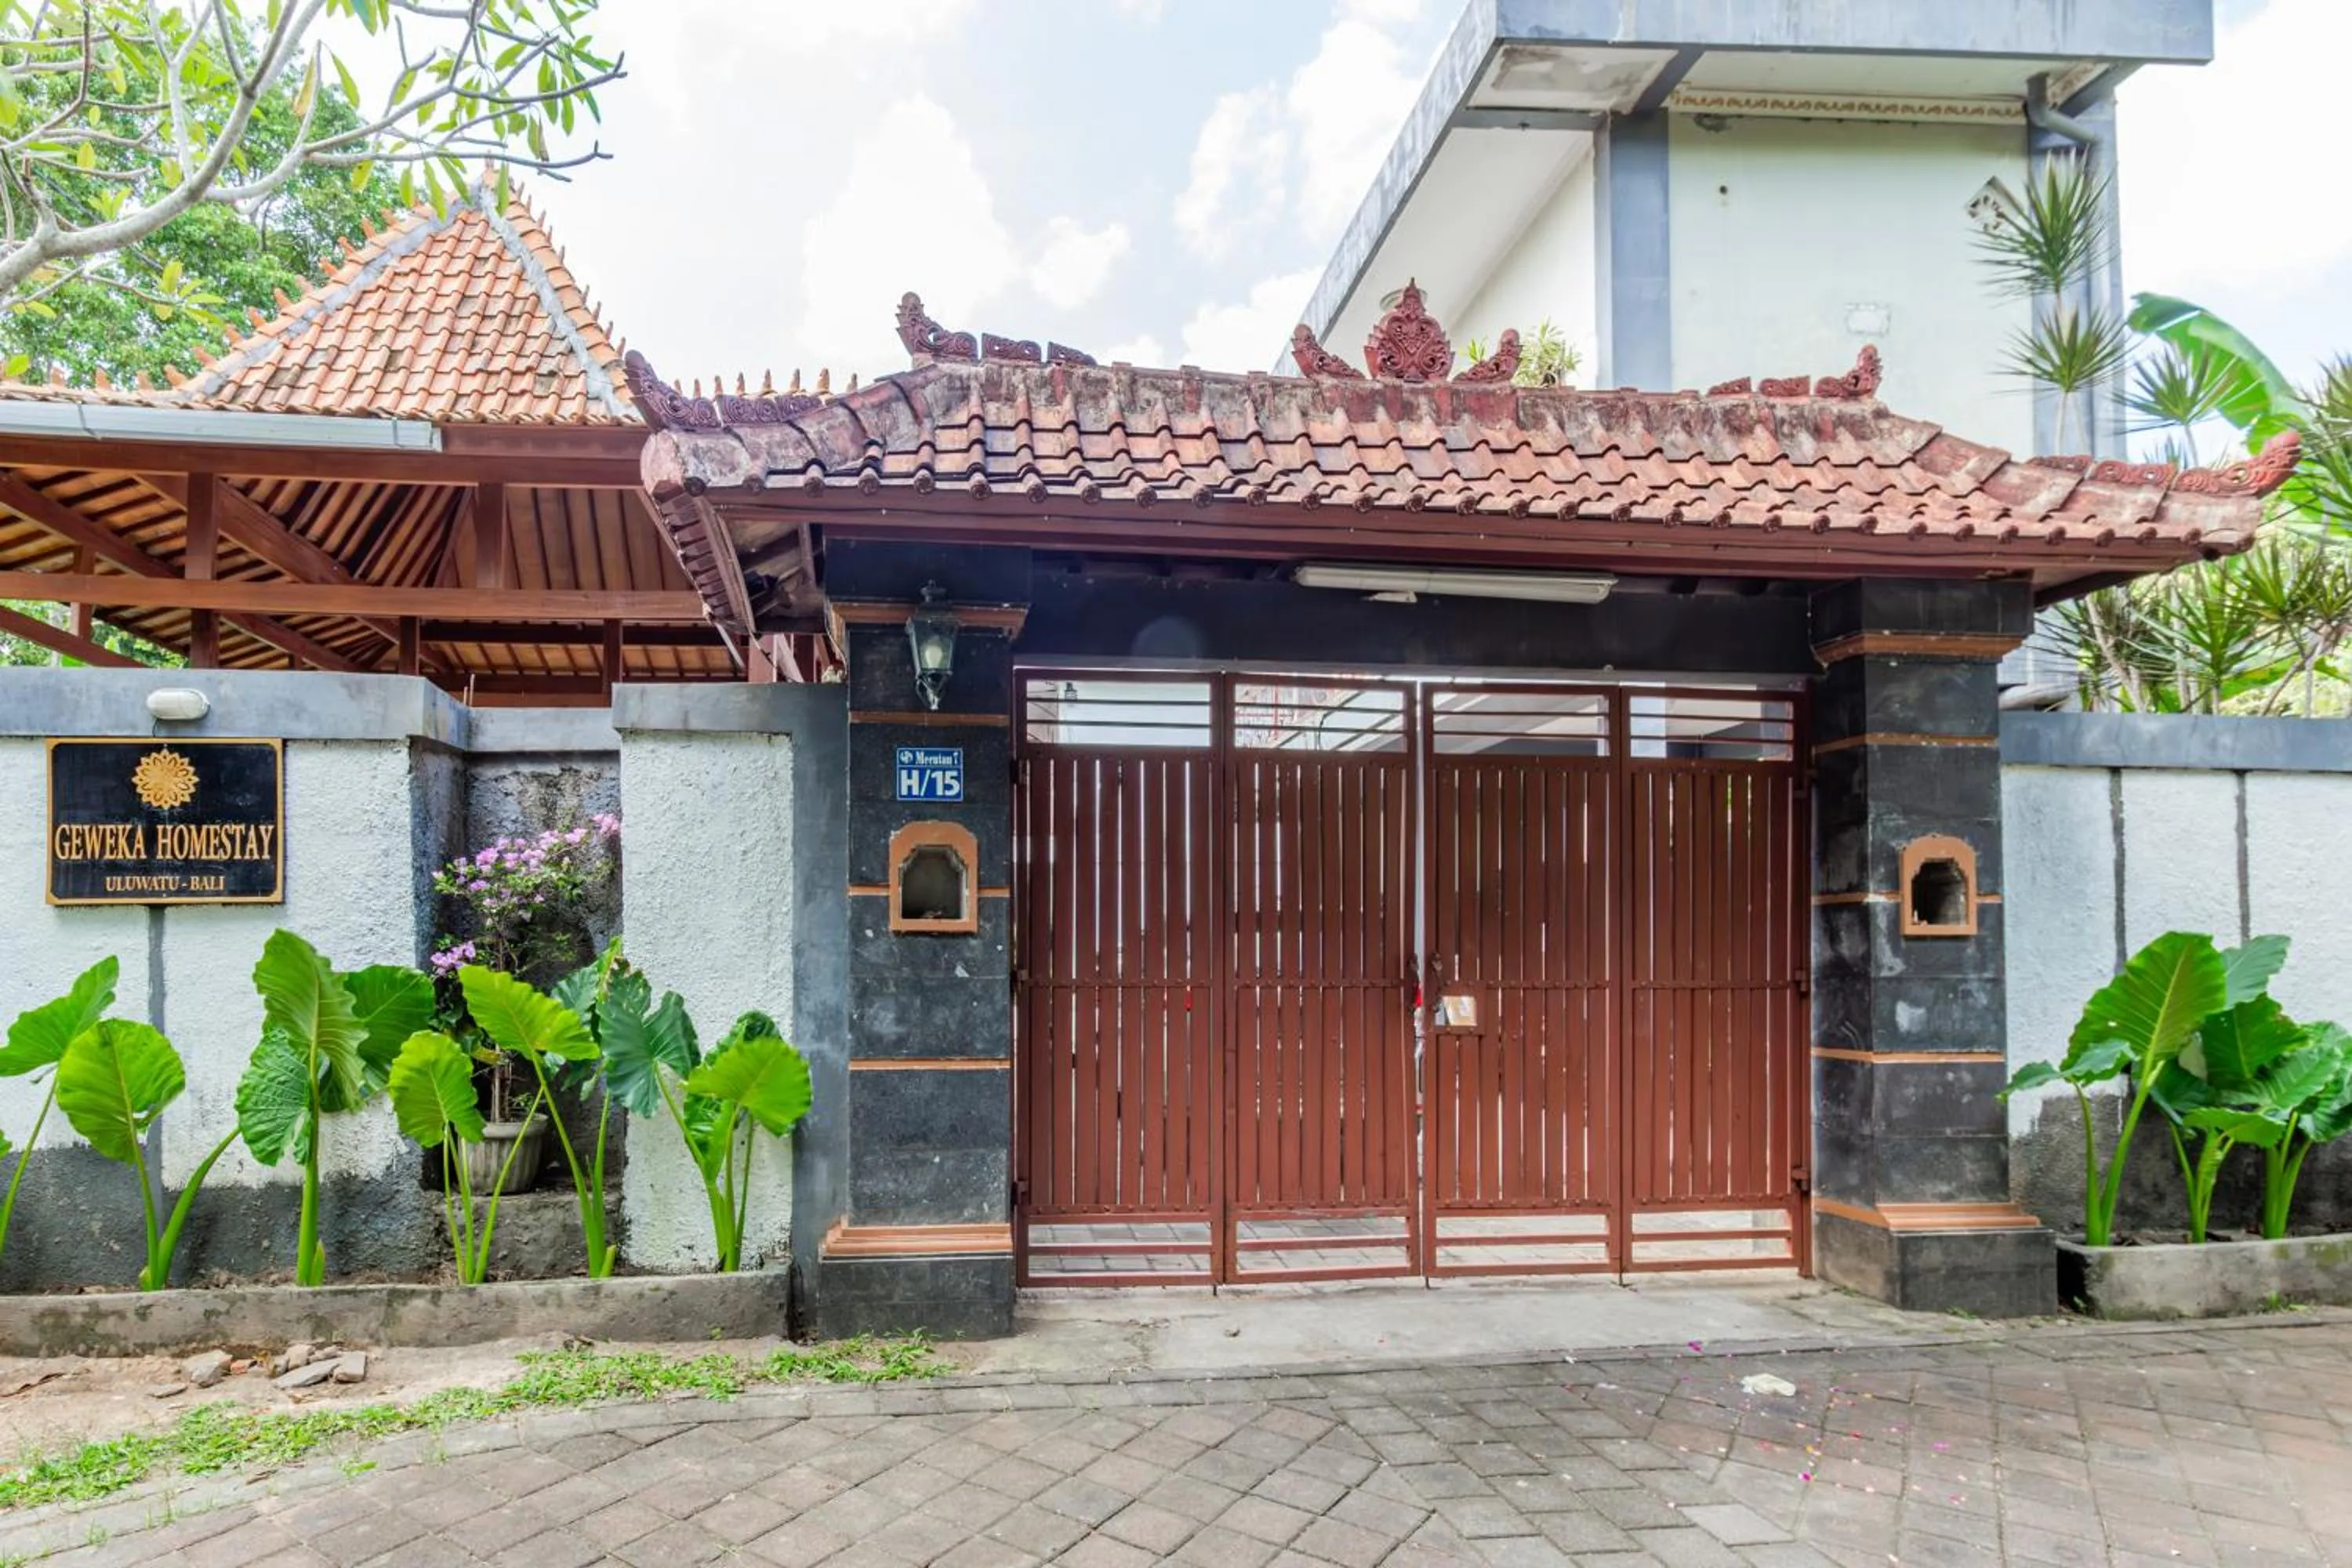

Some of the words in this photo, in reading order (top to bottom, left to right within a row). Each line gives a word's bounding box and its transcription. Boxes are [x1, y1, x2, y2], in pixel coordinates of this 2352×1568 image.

[901, 769, 960, 797] H/15
[55, 824, 147, 860] GEWEKA
[158, 824, 274, 860] HOMESTAY
[106, 876, 179, 891] ULUWATU
[191, 876, 226, 891] BALI
